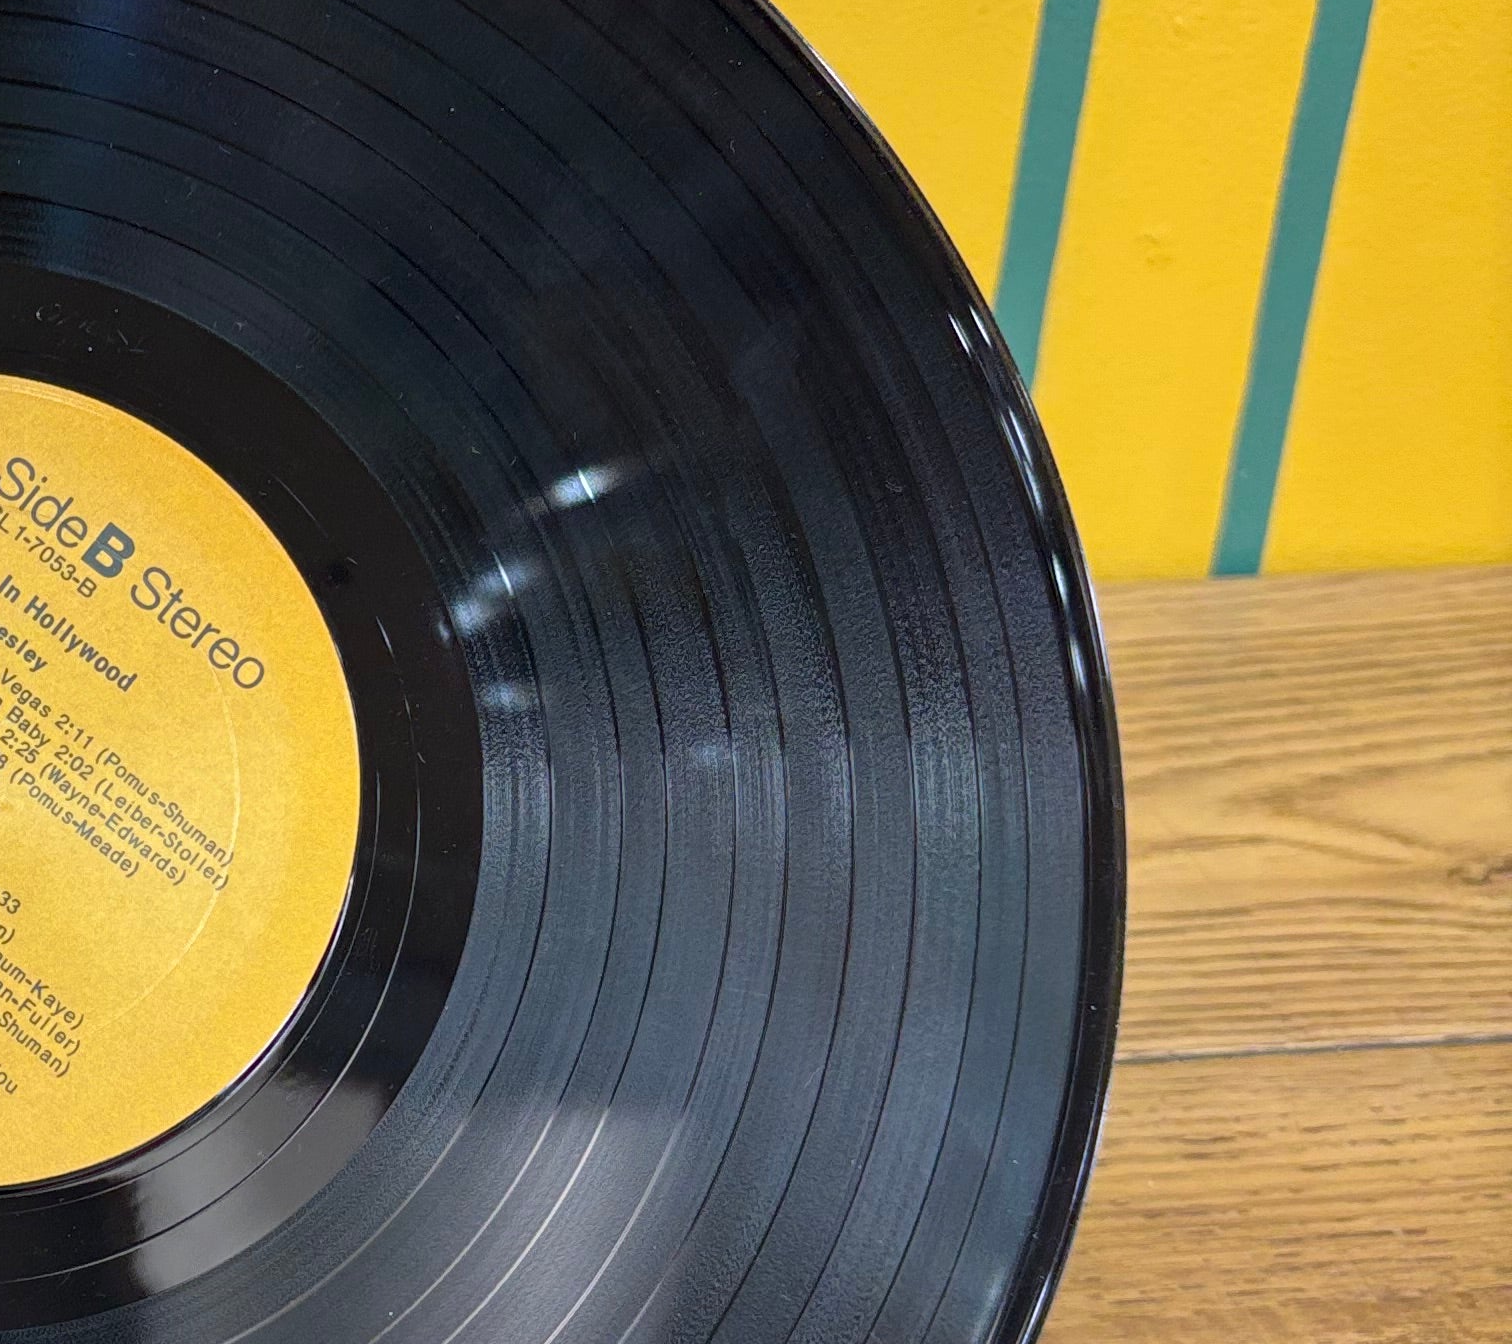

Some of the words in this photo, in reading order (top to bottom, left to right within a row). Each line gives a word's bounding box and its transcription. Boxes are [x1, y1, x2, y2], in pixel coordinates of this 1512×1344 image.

[23, 594, 138, 692] Hollywood
[80, 521, 136, 579] B
[130, 566, 265, 689] Stereo
[0, 728, 40, 764] 2:25
[39, 762, 186, 886] (Wayne-Edwards)
[1, 667, 52, 718] Vegas
[54, 713, 94, 750] 2:11
[95, 748, 234, 867] (Pomus-Shuman)
[5, 705, 52, 748] Baby
[53, 744, 94, 781] 2:02
[94, 778, 229, 891] (Leiber-Stoller)
[9, 767, 140, 878] (Pomus-Meade)
